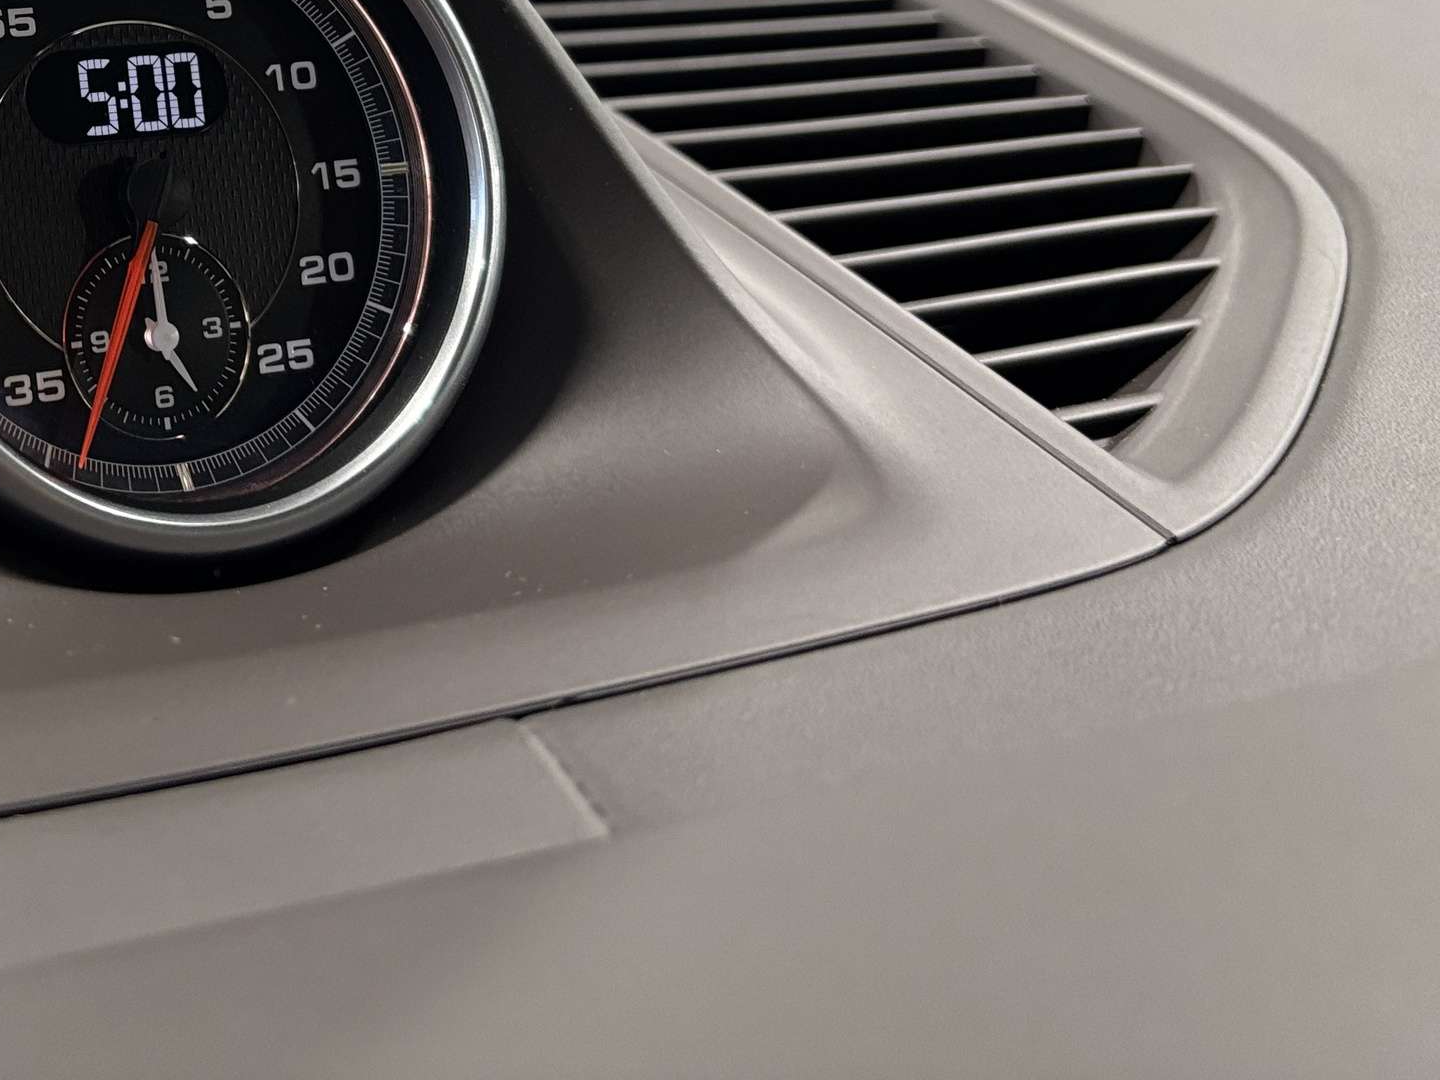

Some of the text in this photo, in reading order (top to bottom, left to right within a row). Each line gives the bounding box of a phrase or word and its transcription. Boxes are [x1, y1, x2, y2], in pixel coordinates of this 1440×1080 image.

[265, 61, 317, 92] 10
[77, 52, 206, 137] 5:00
[311, 158, 361, 190] 15
[299, 251, 354, 286] 20
[90, 330, 110, 354] 9
[202, 316, 223, 339] 3
[257, 338, 314, 374] 25
[3, 370, 66, 406] 35
[154, 385, 175, 409] 6
